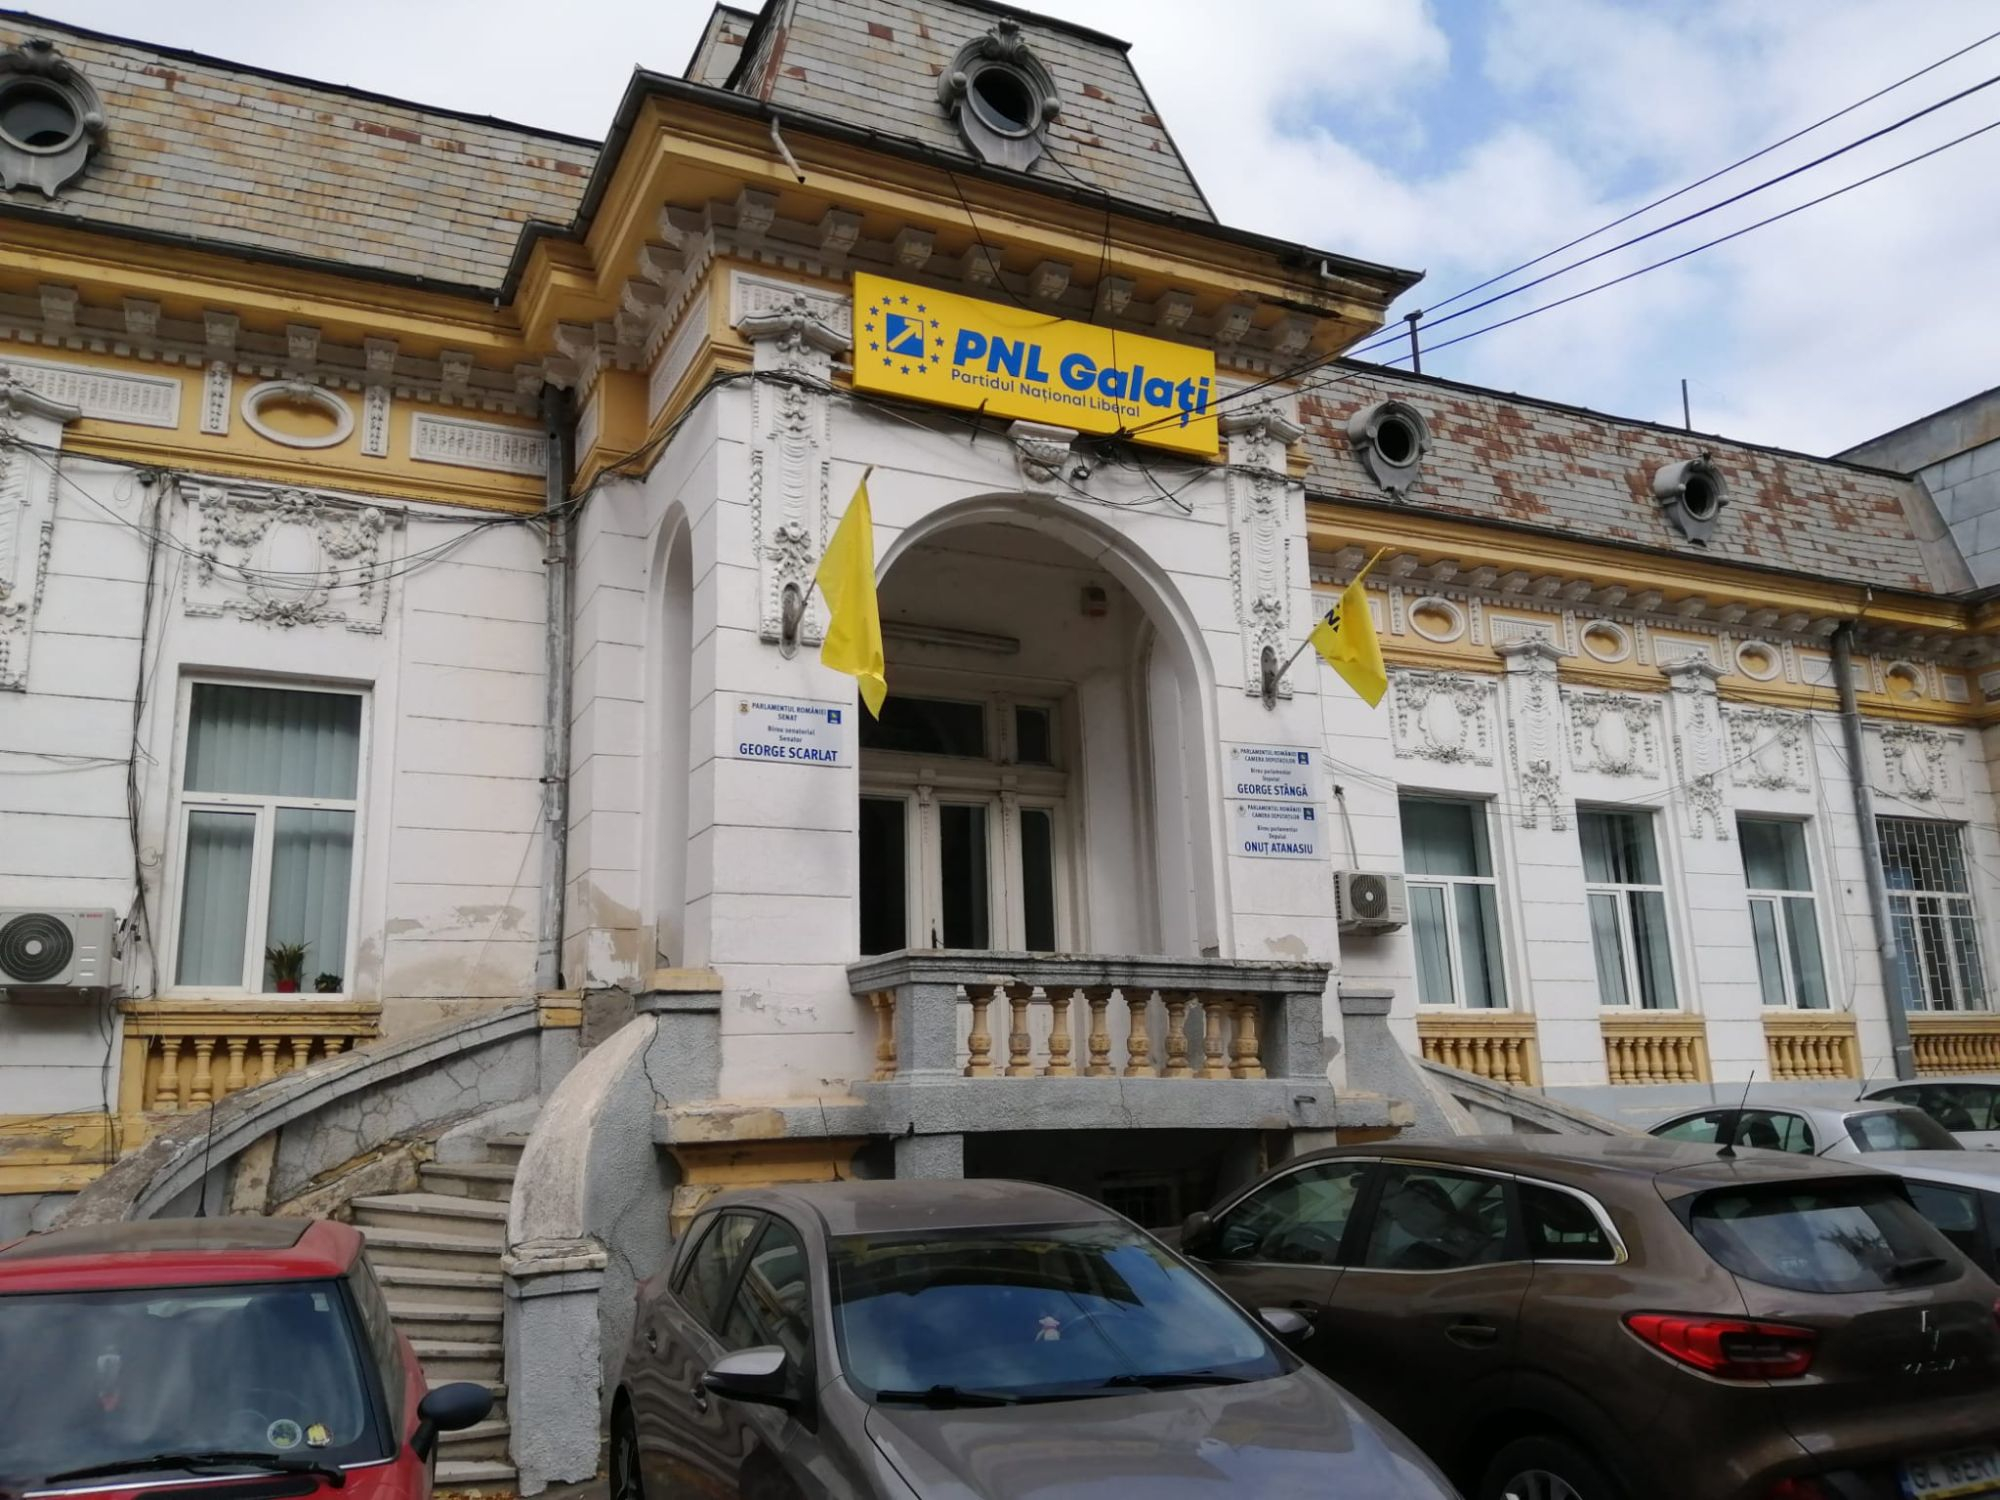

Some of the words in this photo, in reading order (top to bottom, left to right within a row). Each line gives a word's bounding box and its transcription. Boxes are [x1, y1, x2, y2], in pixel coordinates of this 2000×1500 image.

[953, 328, 1049, 383] PNL
[1059, 352, 1210, 428] Galați
[951, 368, 1015, 393] Partidul
[1020, 382, 1087, 407] Național
[1089, 396, 1141, 417] Liberal
[752, 702, 795, 713] PARLAMENTUL
[796, 705, 827, 716] ROMÂNIEI
[778, 713, 798, 721] SENAT
[785, 727, 816, 736] senatorial
[779, 735, 803, 743] Senator
[739, 743, 786, 758] GEORGE
[788, 746, 838, 762] SCARLAT
[1237, 783, 1273, 796] GEORGE
[1274, 782, 1309, 797] STÂNGĂ
[1244, 841, 1270, 855] ONUȚ
[1271, 842, 1314, 855] ATANASIU
